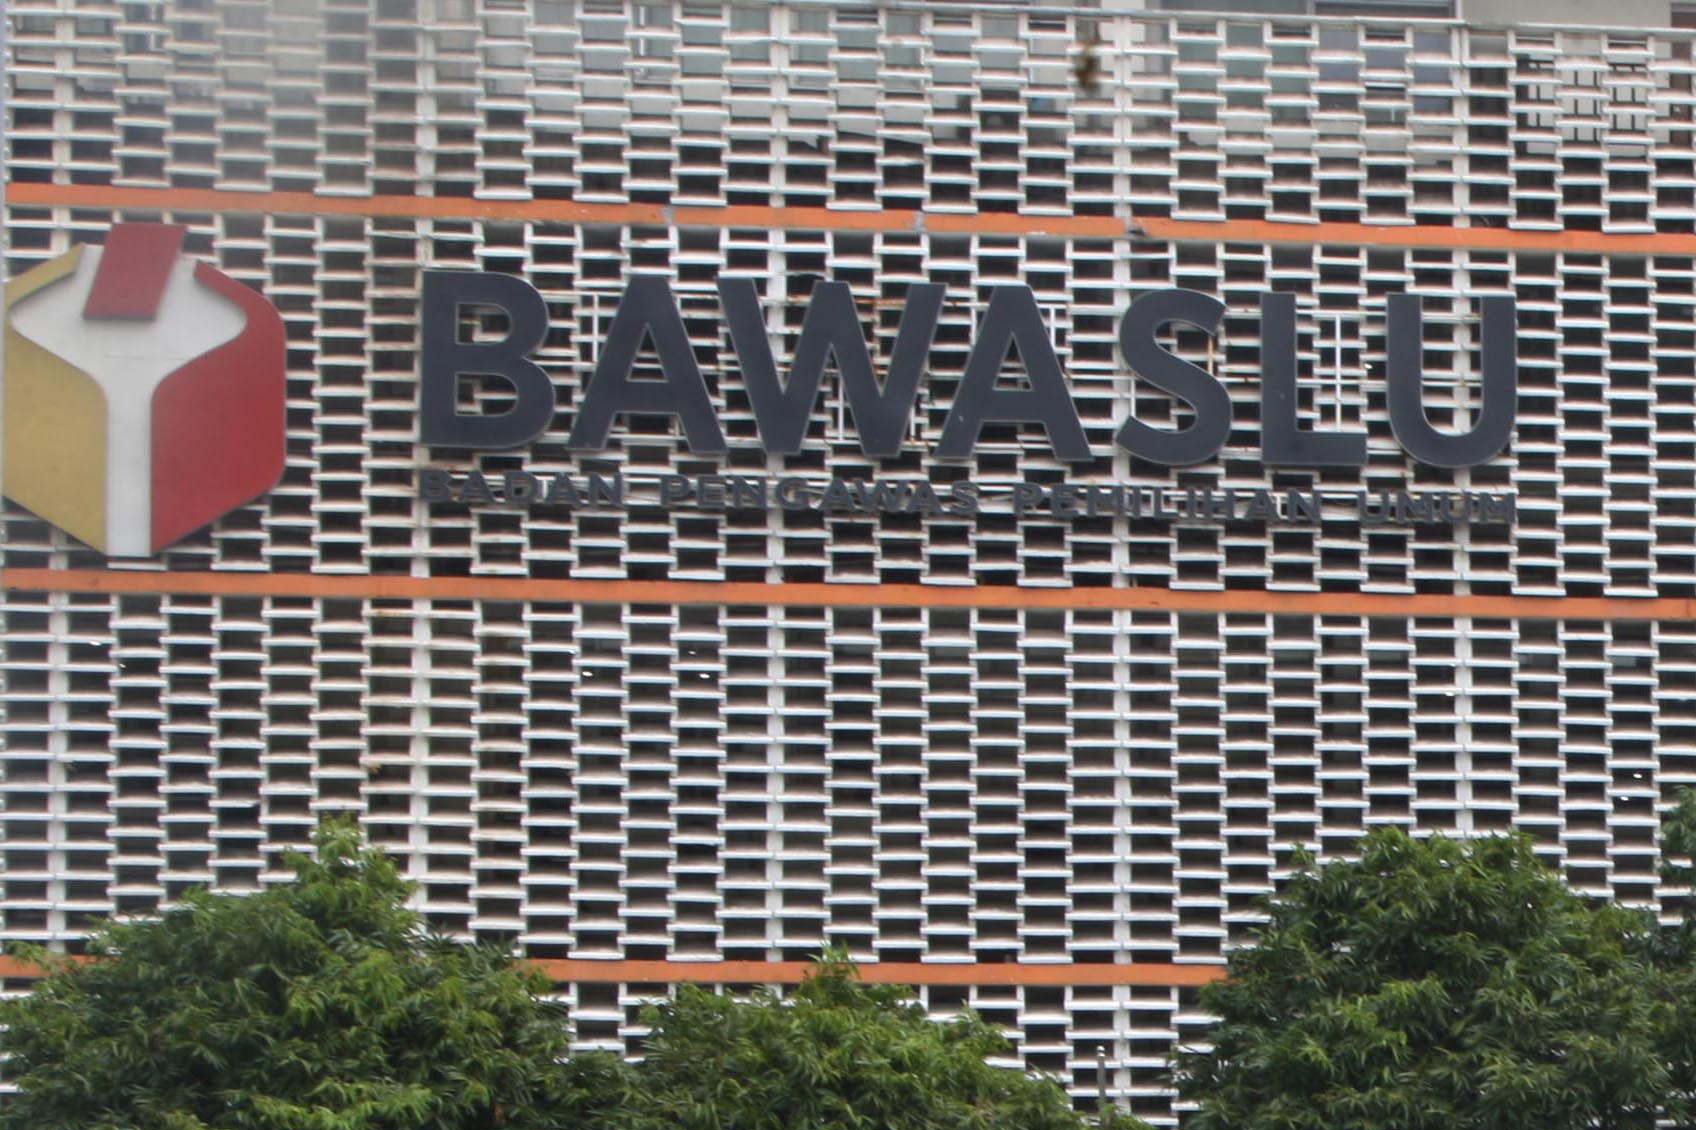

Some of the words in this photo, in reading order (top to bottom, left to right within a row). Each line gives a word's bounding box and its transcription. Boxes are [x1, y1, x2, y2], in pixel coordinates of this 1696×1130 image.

[418, 268, 1518, 468] BAWASLU
[416, 469, 624, 506] BADAN
[659, 473, 984, 515] PENGAWAS
[1013, 482, 1322, 523] PEMILIHAN
[1357, 489, 1518, 525] UMUM
